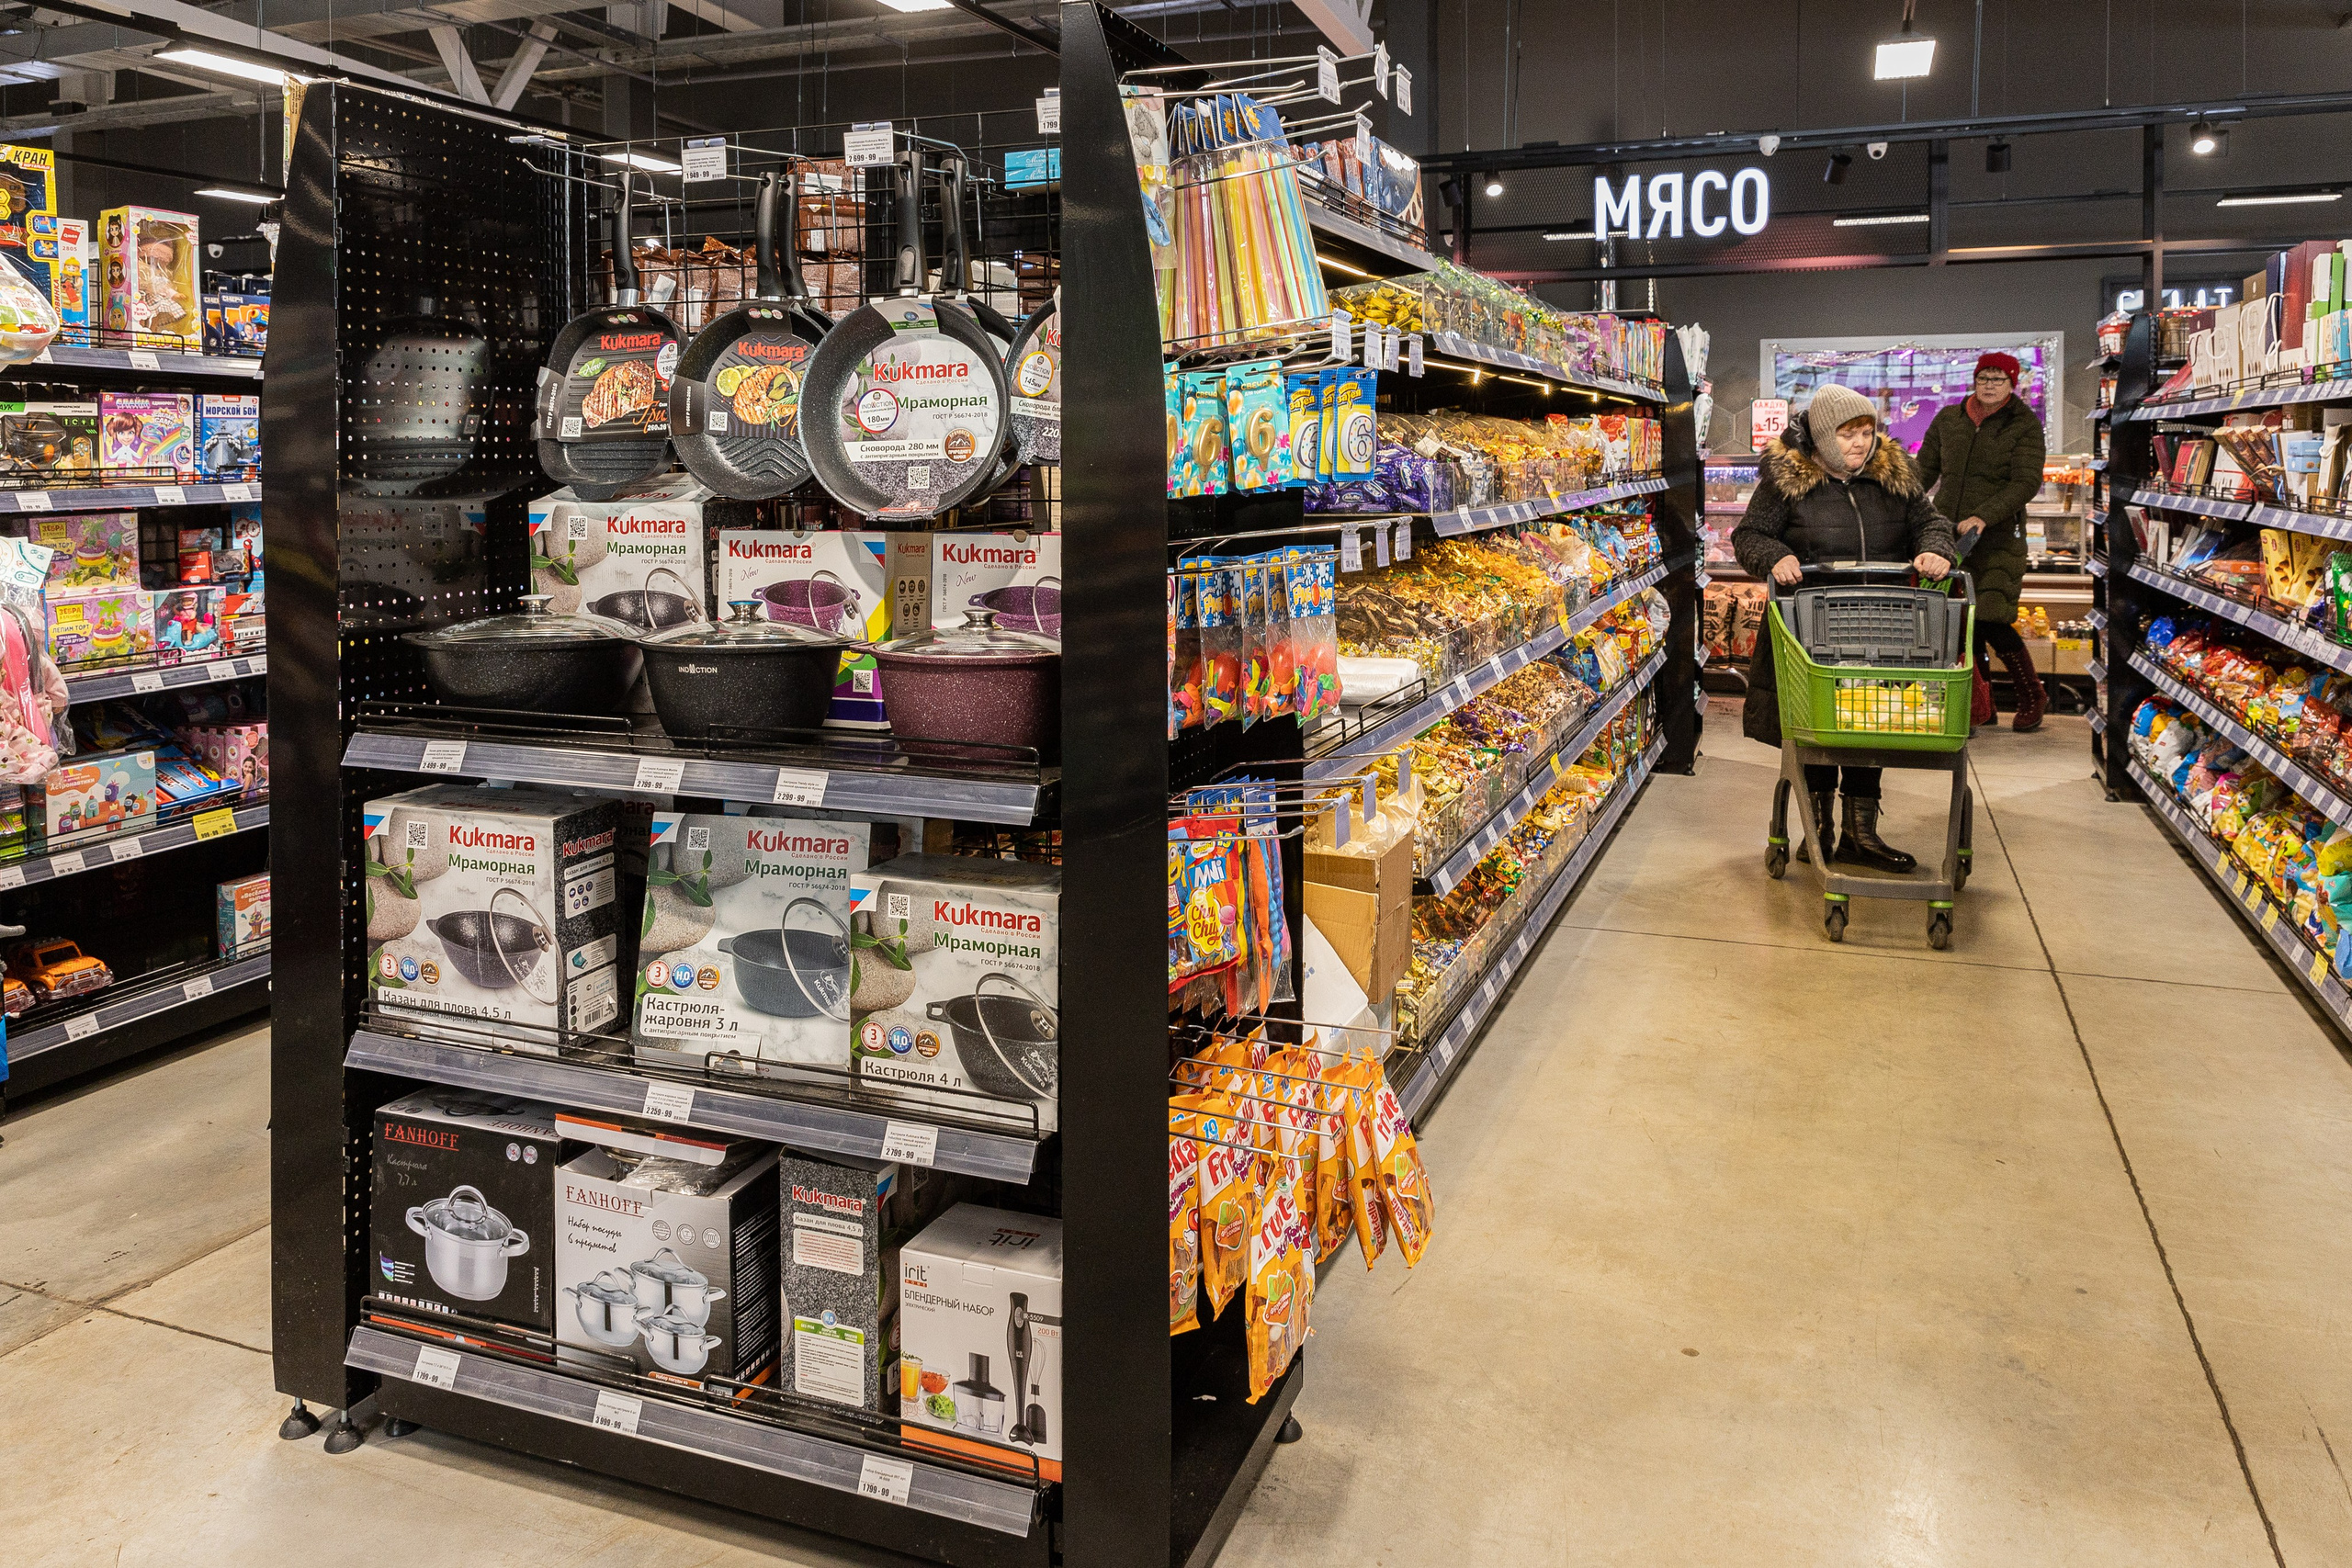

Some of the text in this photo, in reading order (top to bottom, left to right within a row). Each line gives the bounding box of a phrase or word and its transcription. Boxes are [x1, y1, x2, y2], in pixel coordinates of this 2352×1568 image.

[13, 150, 48, 165] КРАН
[1595, 166, 1770, 242] МЯСО
[601, 333, 661, 351] Kukmara
[738, 341, 805, 359] Kukmara
[874, 361, 968, 382] Kukmara
[1241, 380, 1269, 391] СВЕЧА
[1195, 390, 1217, 399] СВЕЧА
[206, 404, 257, 416] МОРСКОЙ БОЙ
[896, 396, 988, 412] Мраморная
[1018, 400, 1051, 411] Сковорода
[866, 415, 890, 424] 180мм
[1042, 427, 1060, 438] 220
[860, 445, 906, 453] Сковорода
[908, 443, 923, 451] 280
[606, 516, 686, 536] Kukmara
[606, 542, 686, 558] Мраморная
[729, 539, 812, 559] Kukmara
[897, 542, 926, 555] Kukmara
[943, 543, 1036, 564] Kukmara
[741, 566, 759, 581] New
[956, 573, 978, 587] New
[678, 663, 718, 674] INDUCTION
[50, 778, 96, 792] Астронавтики
[449, 825, 535, 851] Kukmara
[563, 830, 614, 857] Kukmara
[746, 829, 849, 854] Kukmara
[448, 854, 536, 875] Мраморная
[744, 859, 847, 879] Мраморная
[504, 878, 536, 886] 56674-2018
[811, 883, 846, 891] 56674-2018
[933, 901, 1041, 932] Kukmara
[980, 927, 1041, 940] Сделано России
[933, 931, 1041, 959] Мраморная
[386, 958, 391, 969] 3
[654, 966, 662, 977] 3
[1003, 962, 1041, 972] 56674-2018
[383, 990, 478, 1017] Казан для плова
[647, 997, 725, 1015] Кастрюля-
[644, 1014, 739, 1032] жаровня 3 л
[649, 1028, 737, 1040] антипригарным покрытием
[870, 1028, 877, 1041] 3
[865, 1061, 962, 1088] Кастрюля 4 л
[1021, 1055, 1046, 1089] Kukmara
[384, 1122, 459, 1148] FANHOFF
[1202, 1118, 1219, 1138] 10
[566, 1185, 642, 1213] FANHOFF
[793, 1185, 862, 1212] Kukmara
[568, 1214, 623, 1238] Набор посуды
[795, 1215, 814, 1224] Казан
[827, 1222, 845, 1230] плова
[574, 1237, 617, 1254] предметов
[904, 1263, 927, 1282] irit
[904, 1289, 995, 1317] БЛЕНДЕРНЫЙ НАБОР
[905, 1302, 936, 1313] ЭЛЕКТРИЧЕСКИЙ
[1023, 1313, 1044, 1323] IR-5509
[1037, 1326, 1050, 1336] 200
